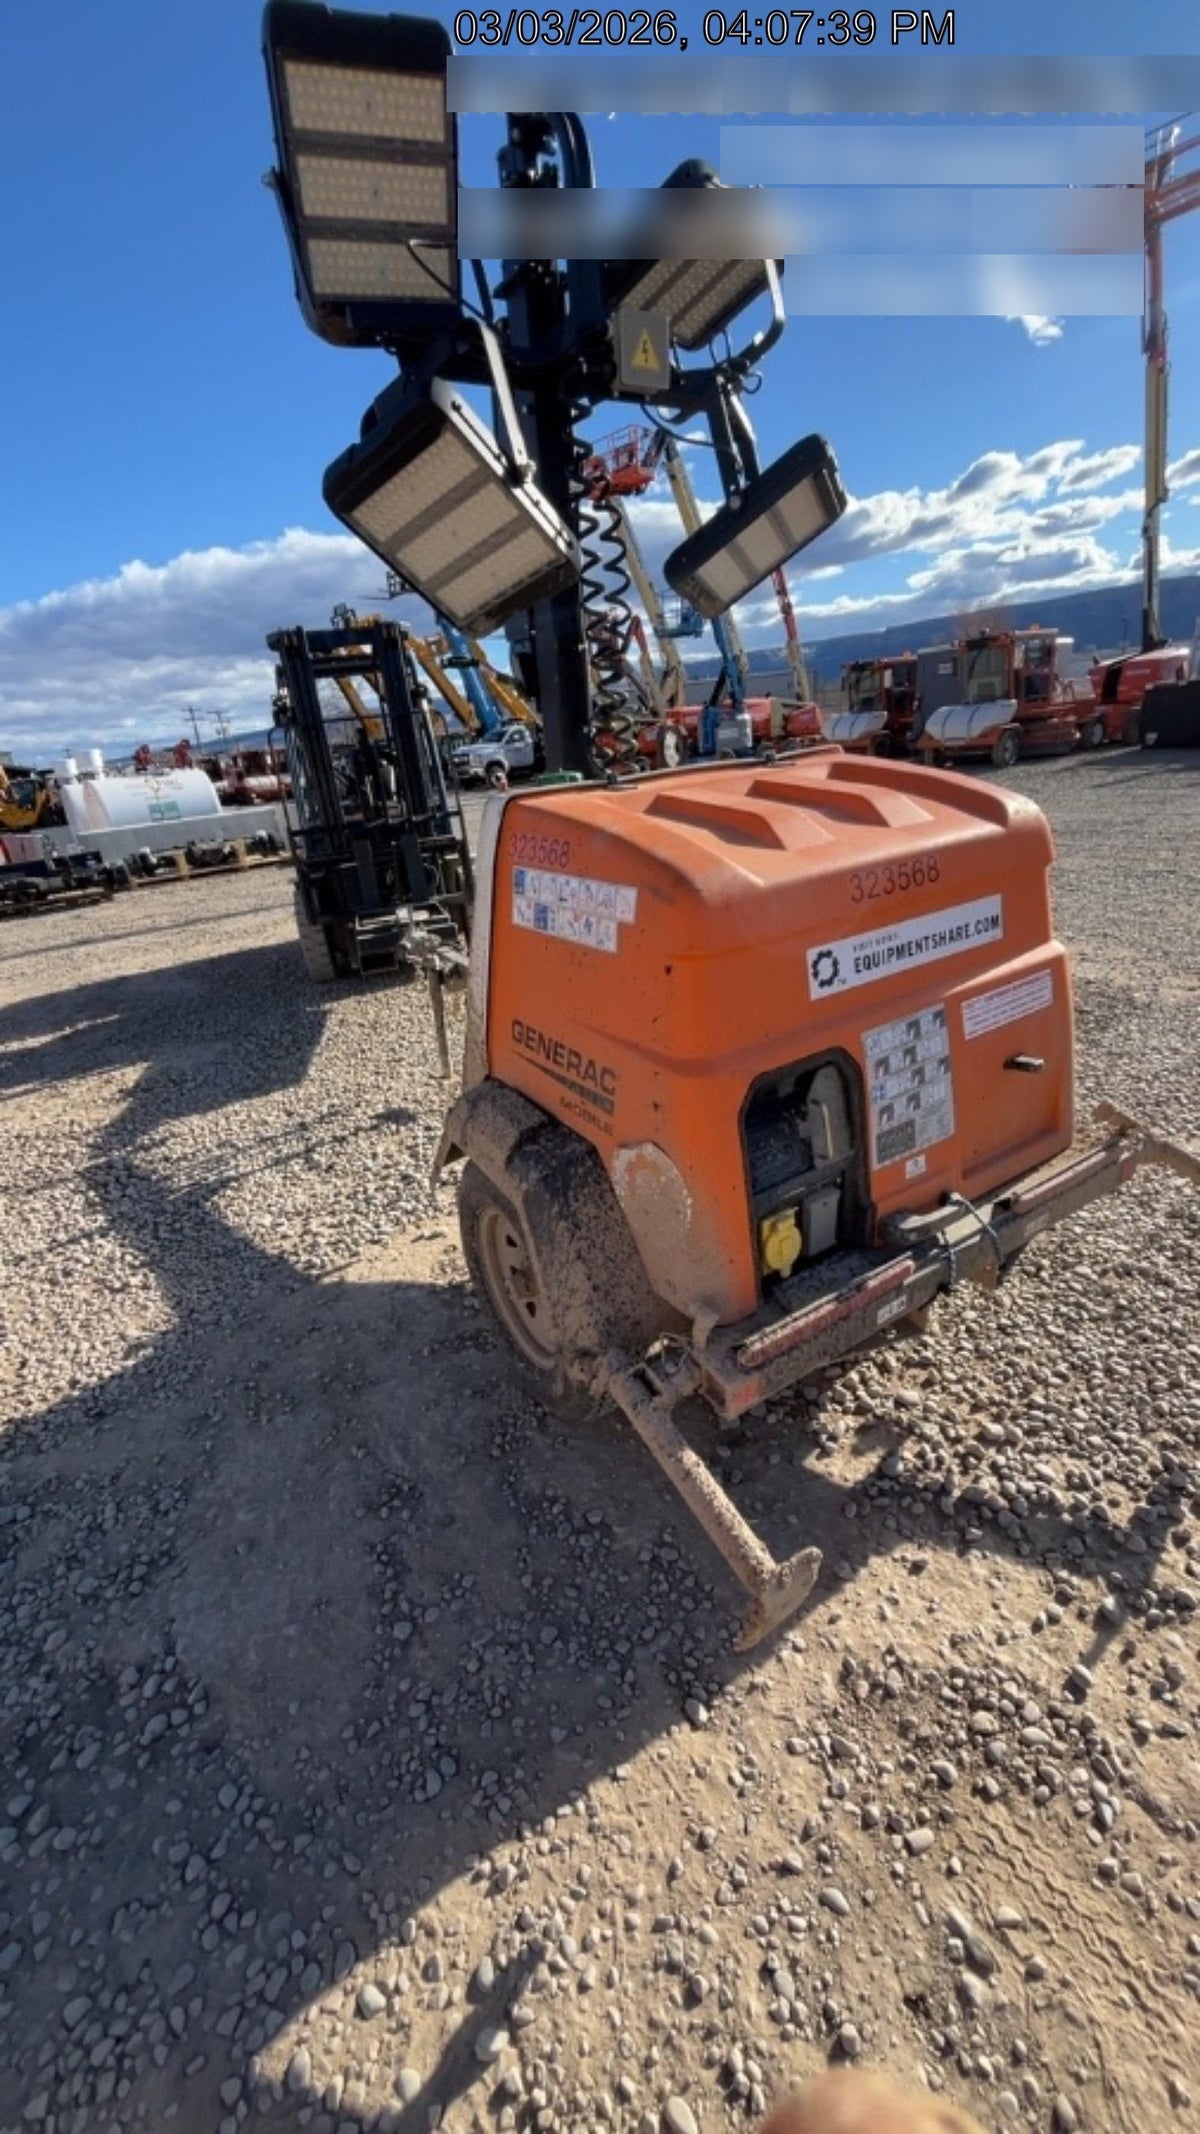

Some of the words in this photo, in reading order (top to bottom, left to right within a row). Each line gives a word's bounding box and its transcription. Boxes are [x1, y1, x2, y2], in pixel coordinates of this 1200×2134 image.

[508, 834, 570, 868] 323568
[849, 855, 940, 904] 323568
[854, 914, 1000, 974] EQUIPMENTSHARE.COM
[511, 1019, 616, 1096] GENERAC
[559, 1096, 614, 1136] MOBILE
